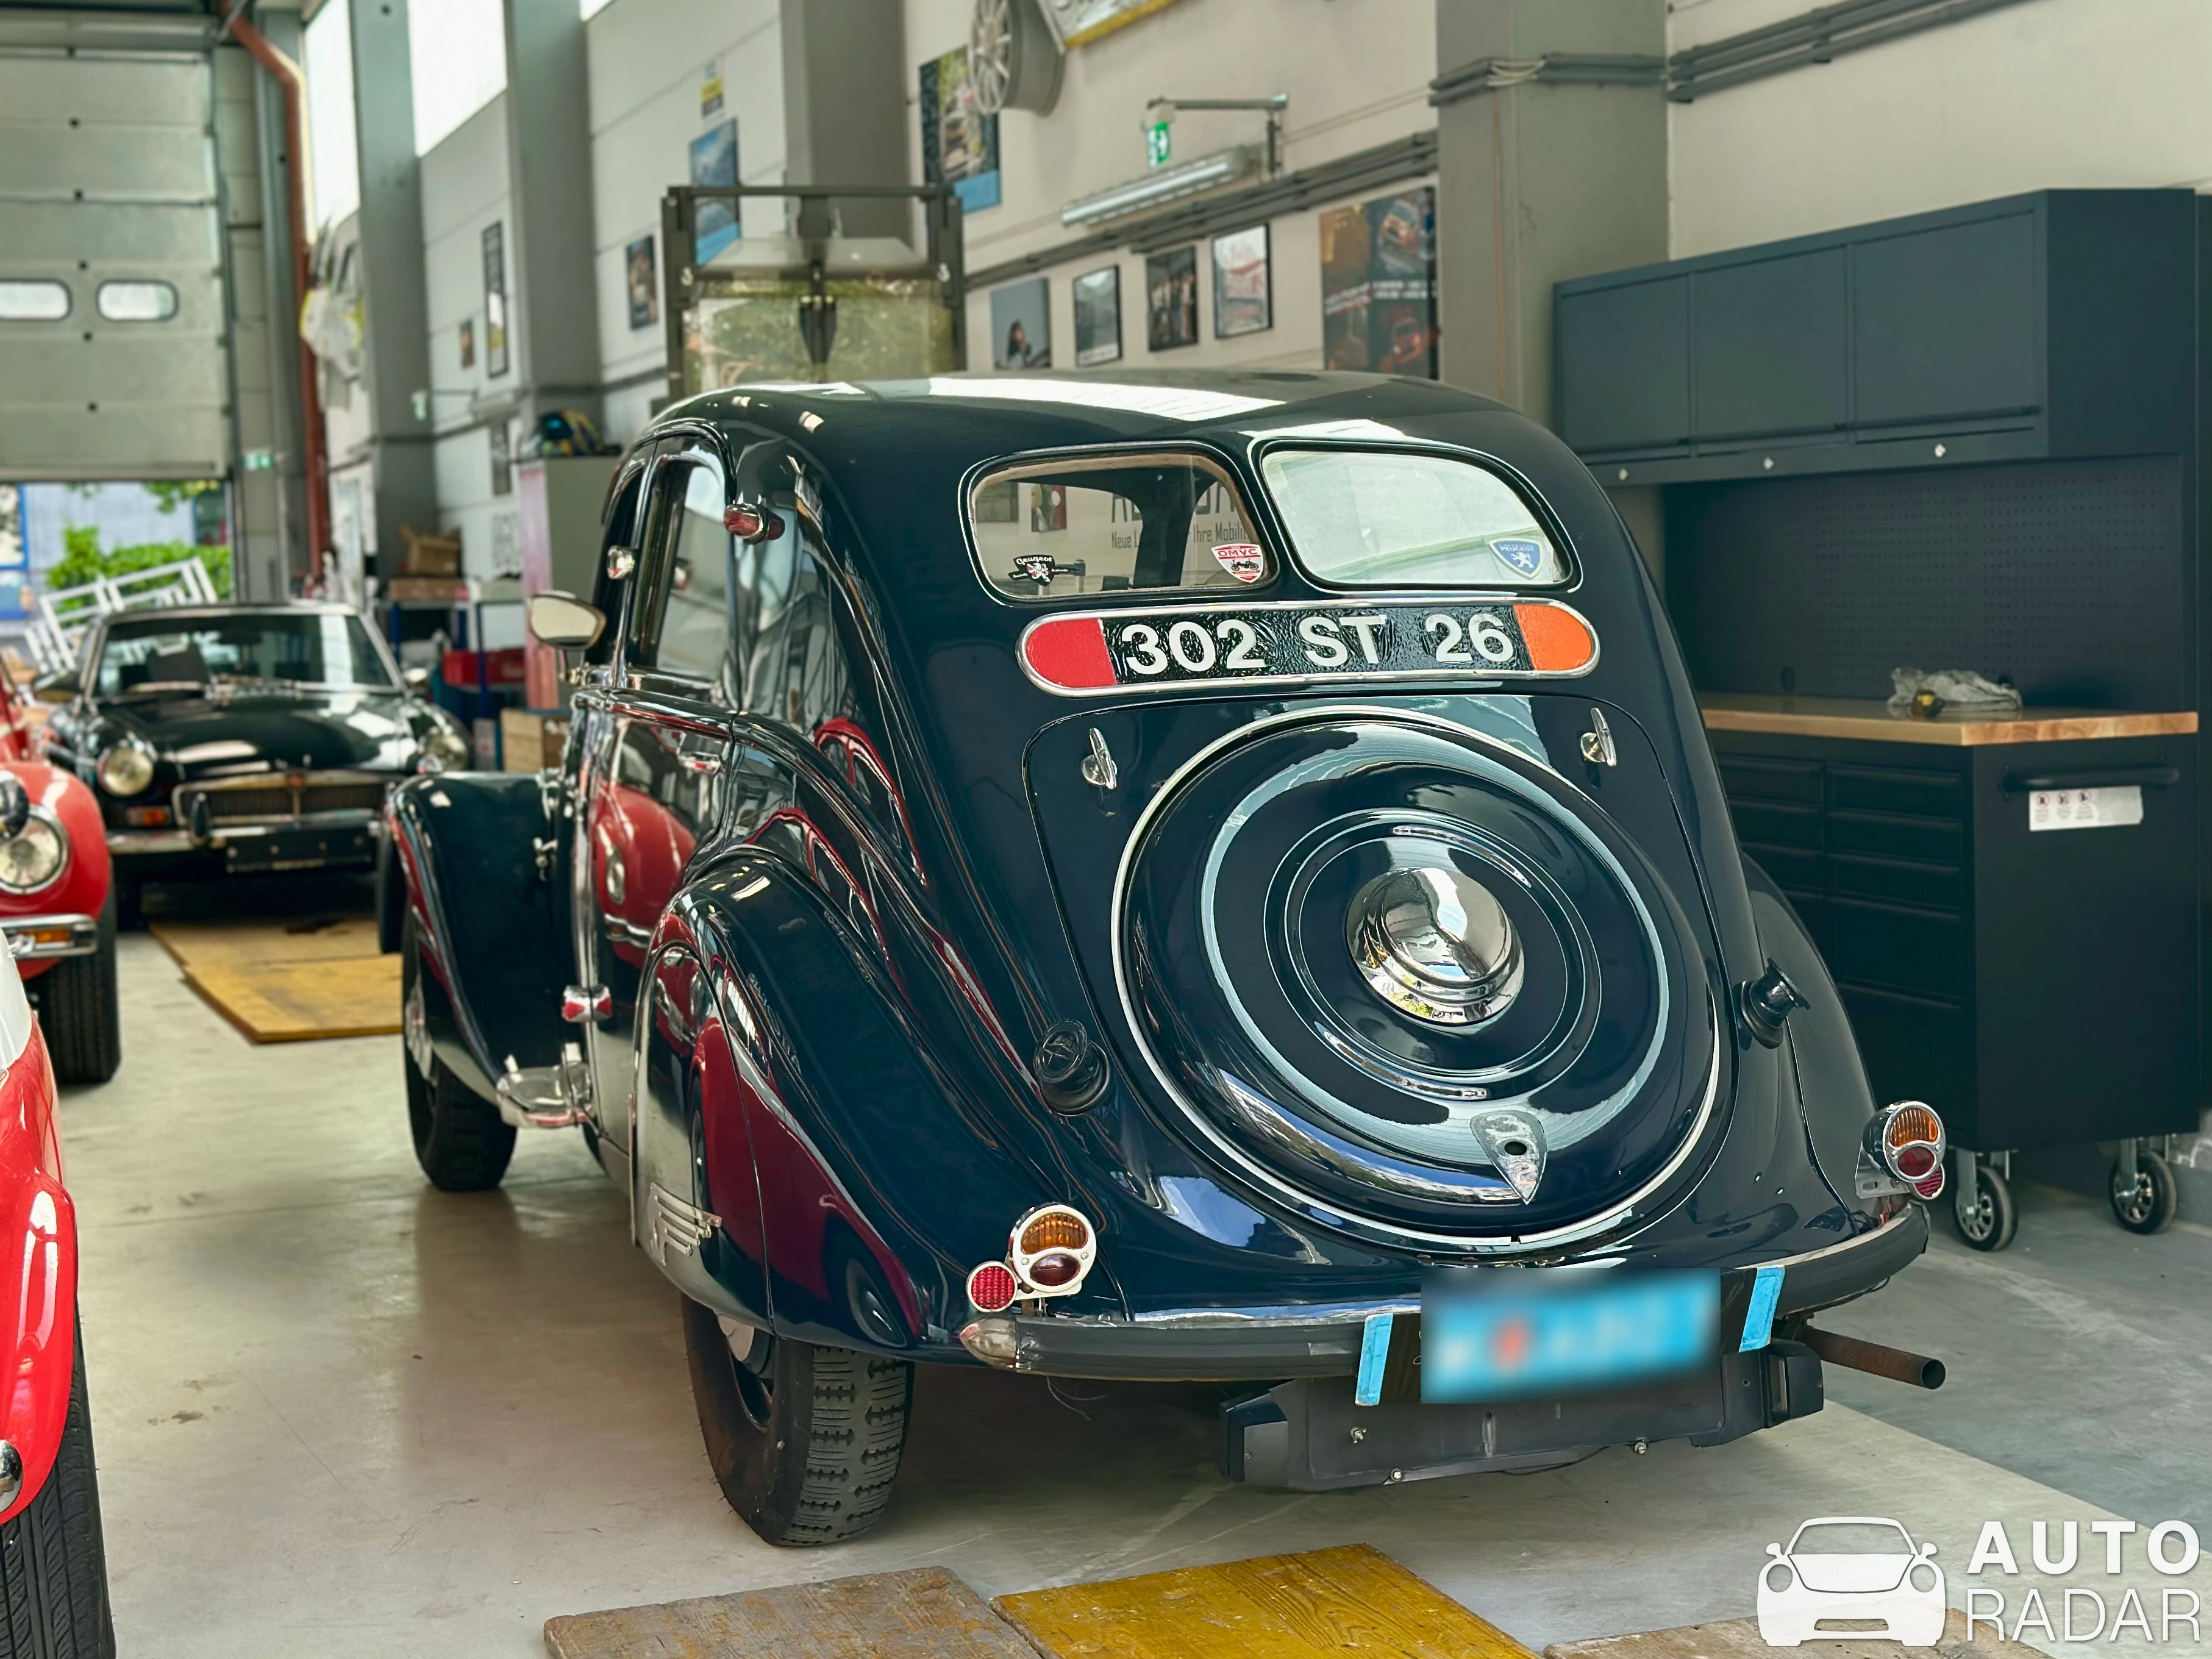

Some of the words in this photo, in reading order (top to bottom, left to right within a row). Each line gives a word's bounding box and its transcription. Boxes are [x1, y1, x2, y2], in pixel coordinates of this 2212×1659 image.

[1111, 530, 1132, 549] Neue
[1193, 523, 1212, 543] Ihre
[1121, 619, 1267, 676] 302
[1299, 614, 1387, 667] ST
[1425, 613, 1514, 663] 26
